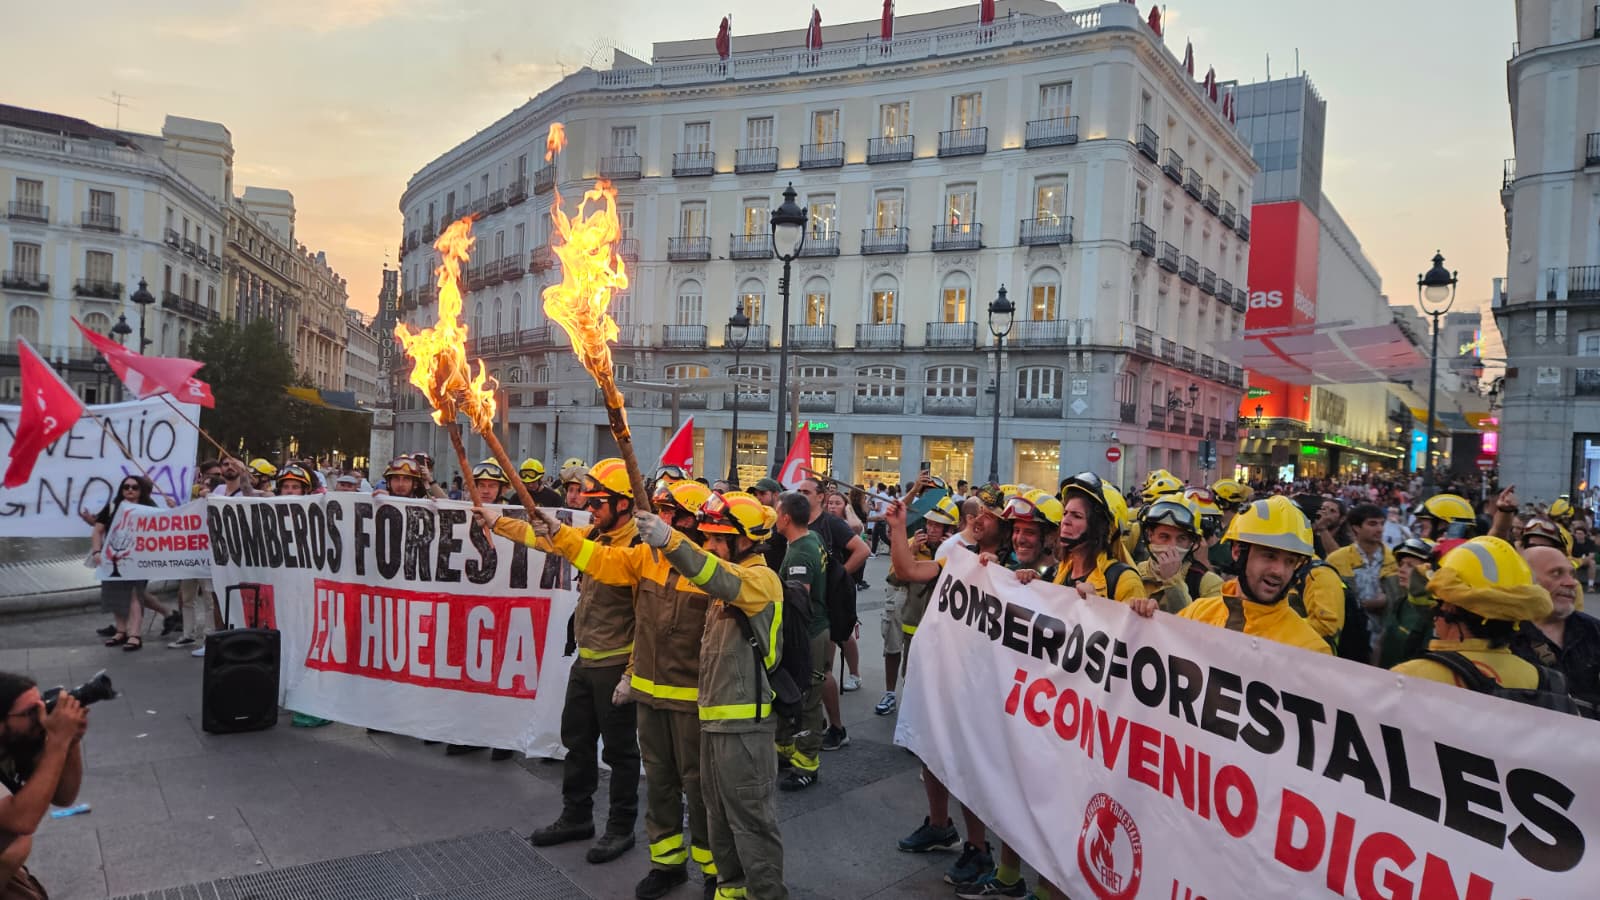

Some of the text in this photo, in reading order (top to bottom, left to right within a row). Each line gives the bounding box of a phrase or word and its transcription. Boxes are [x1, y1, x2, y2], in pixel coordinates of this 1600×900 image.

[385, 271, 394, 320] HOTEL
[382, 328, 394, 371] MODE
[134, 534, 209, 552] BOMBER
[135, 515, 202, 532] MADRID
[207, 500, 343, 574] BOMBEROS
[137, 559, 168, 569] CONTRA
[170, 559, 200, 568] TRAGSA
[310, 588, 539, 691] EN HUELGA
[1004, 668, 1495, 900] ¡CONVENIO DIGN
